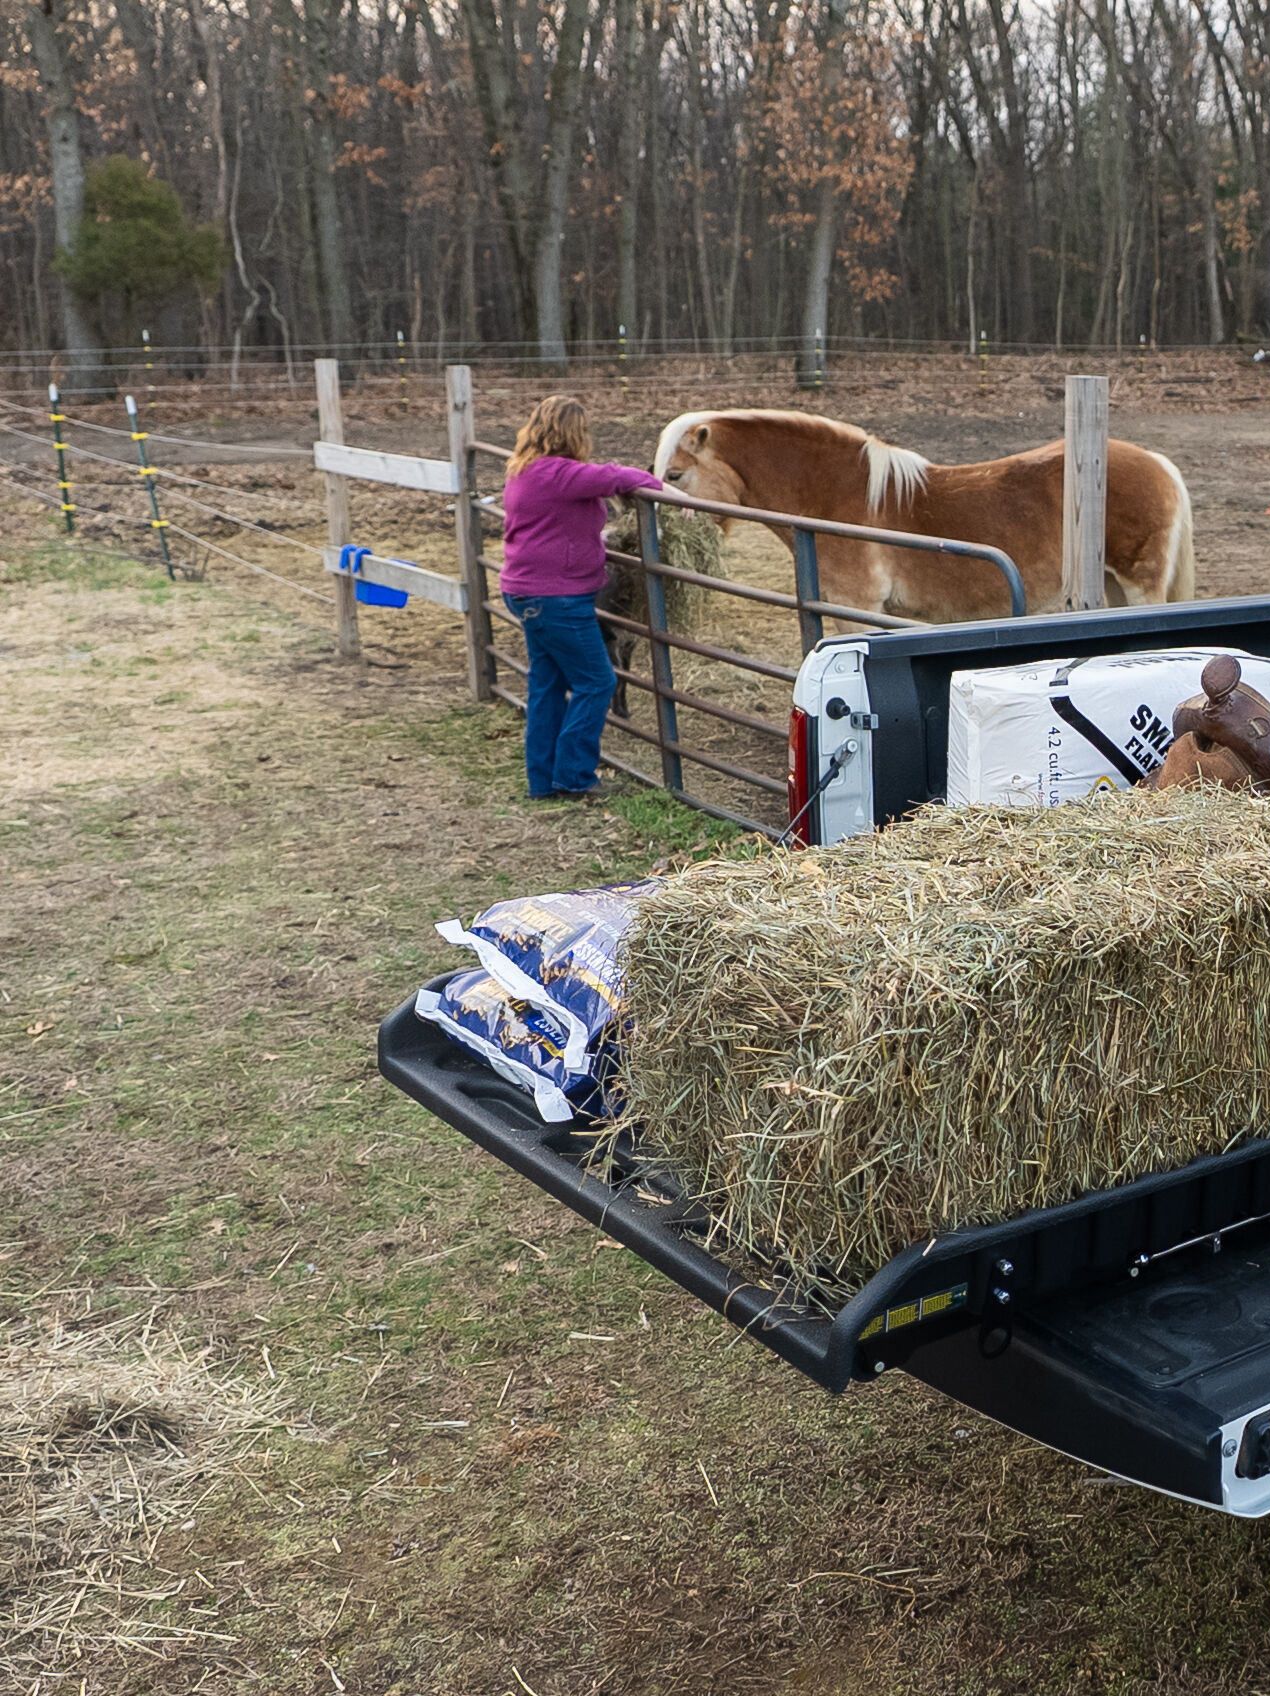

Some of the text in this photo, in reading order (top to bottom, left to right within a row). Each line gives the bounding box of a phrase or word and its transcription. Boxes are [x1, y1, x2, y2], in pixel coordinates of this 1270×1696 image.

[1048, 726, 1062, 748] 4.2
[1129, 703, 1174, 761] SMA
[1124, 735, 1163, 773] FLAK
